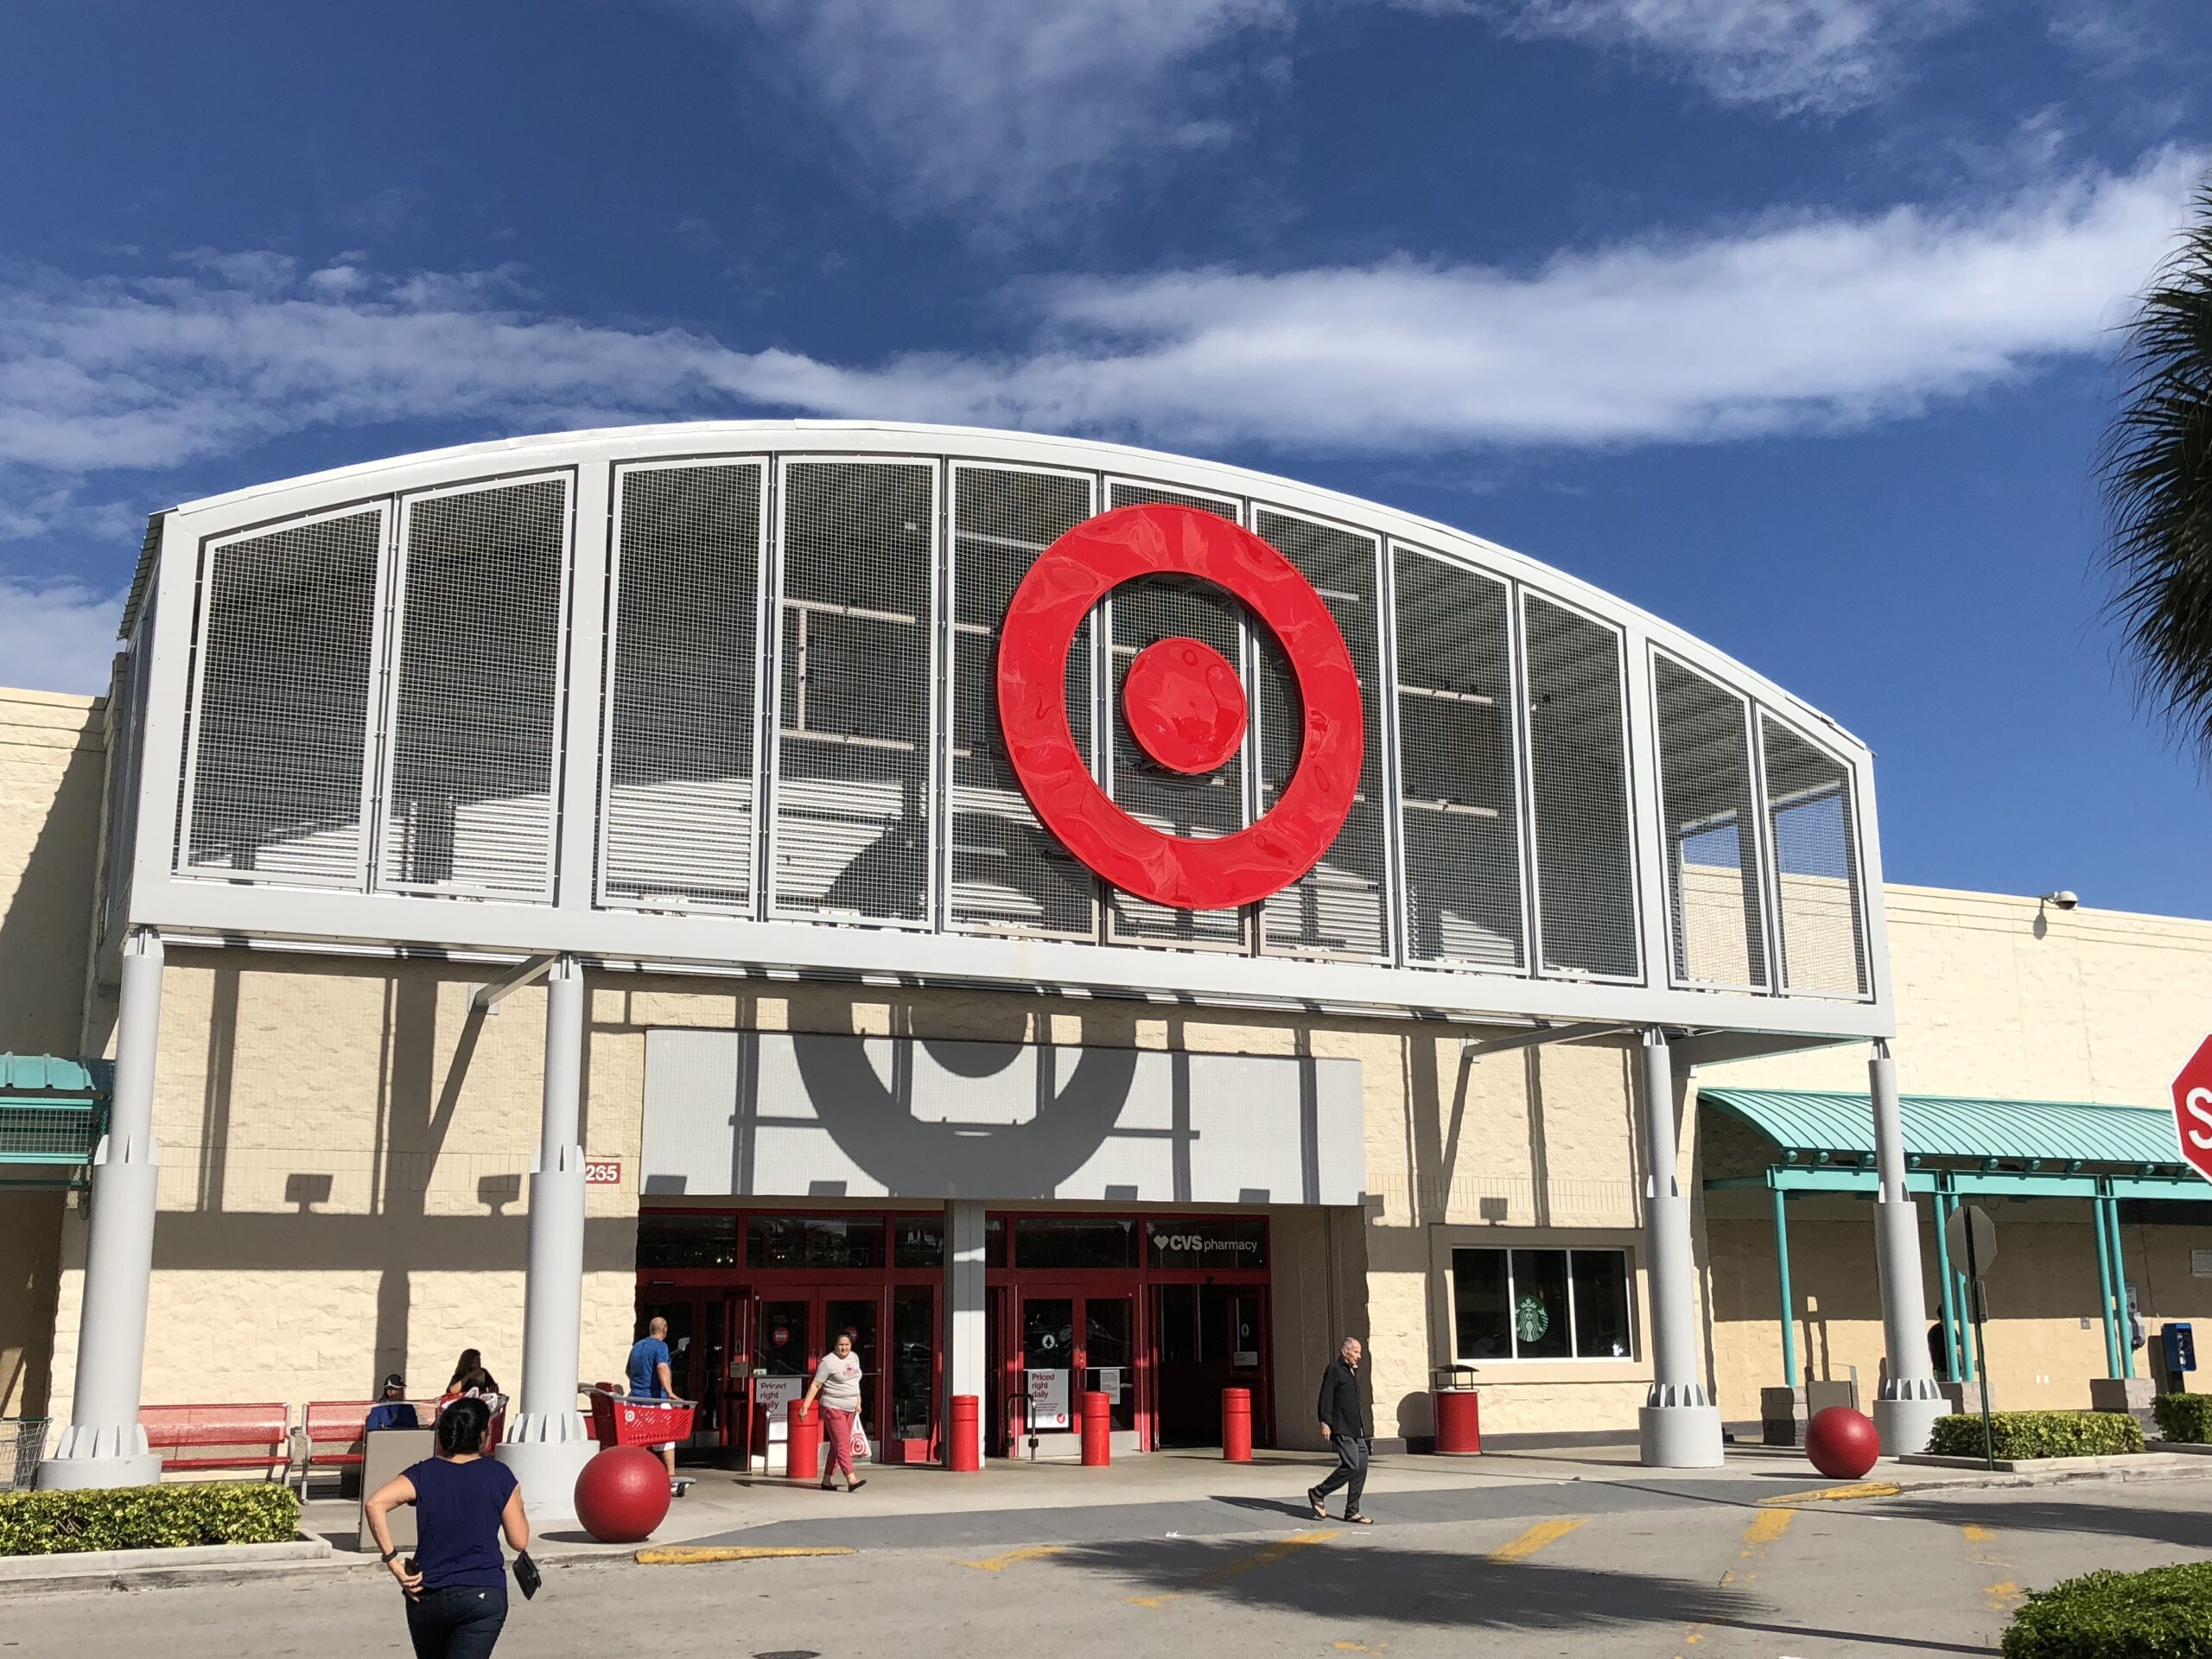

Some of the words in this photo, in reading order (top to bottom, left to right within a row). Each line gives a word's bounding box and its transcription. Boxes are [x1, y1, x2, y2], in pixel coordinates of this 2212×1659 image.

[585, 1164, 617, 1181] 265
[1170, 1235, 1203, 1251] CVS
[1204, 1238, 1258, 1253] pharmacy
[1032, 1382, 1048, 1391] right
[1032, 1391, 1049, 1400] daily
[763, 1401, 779, 1409] aily
